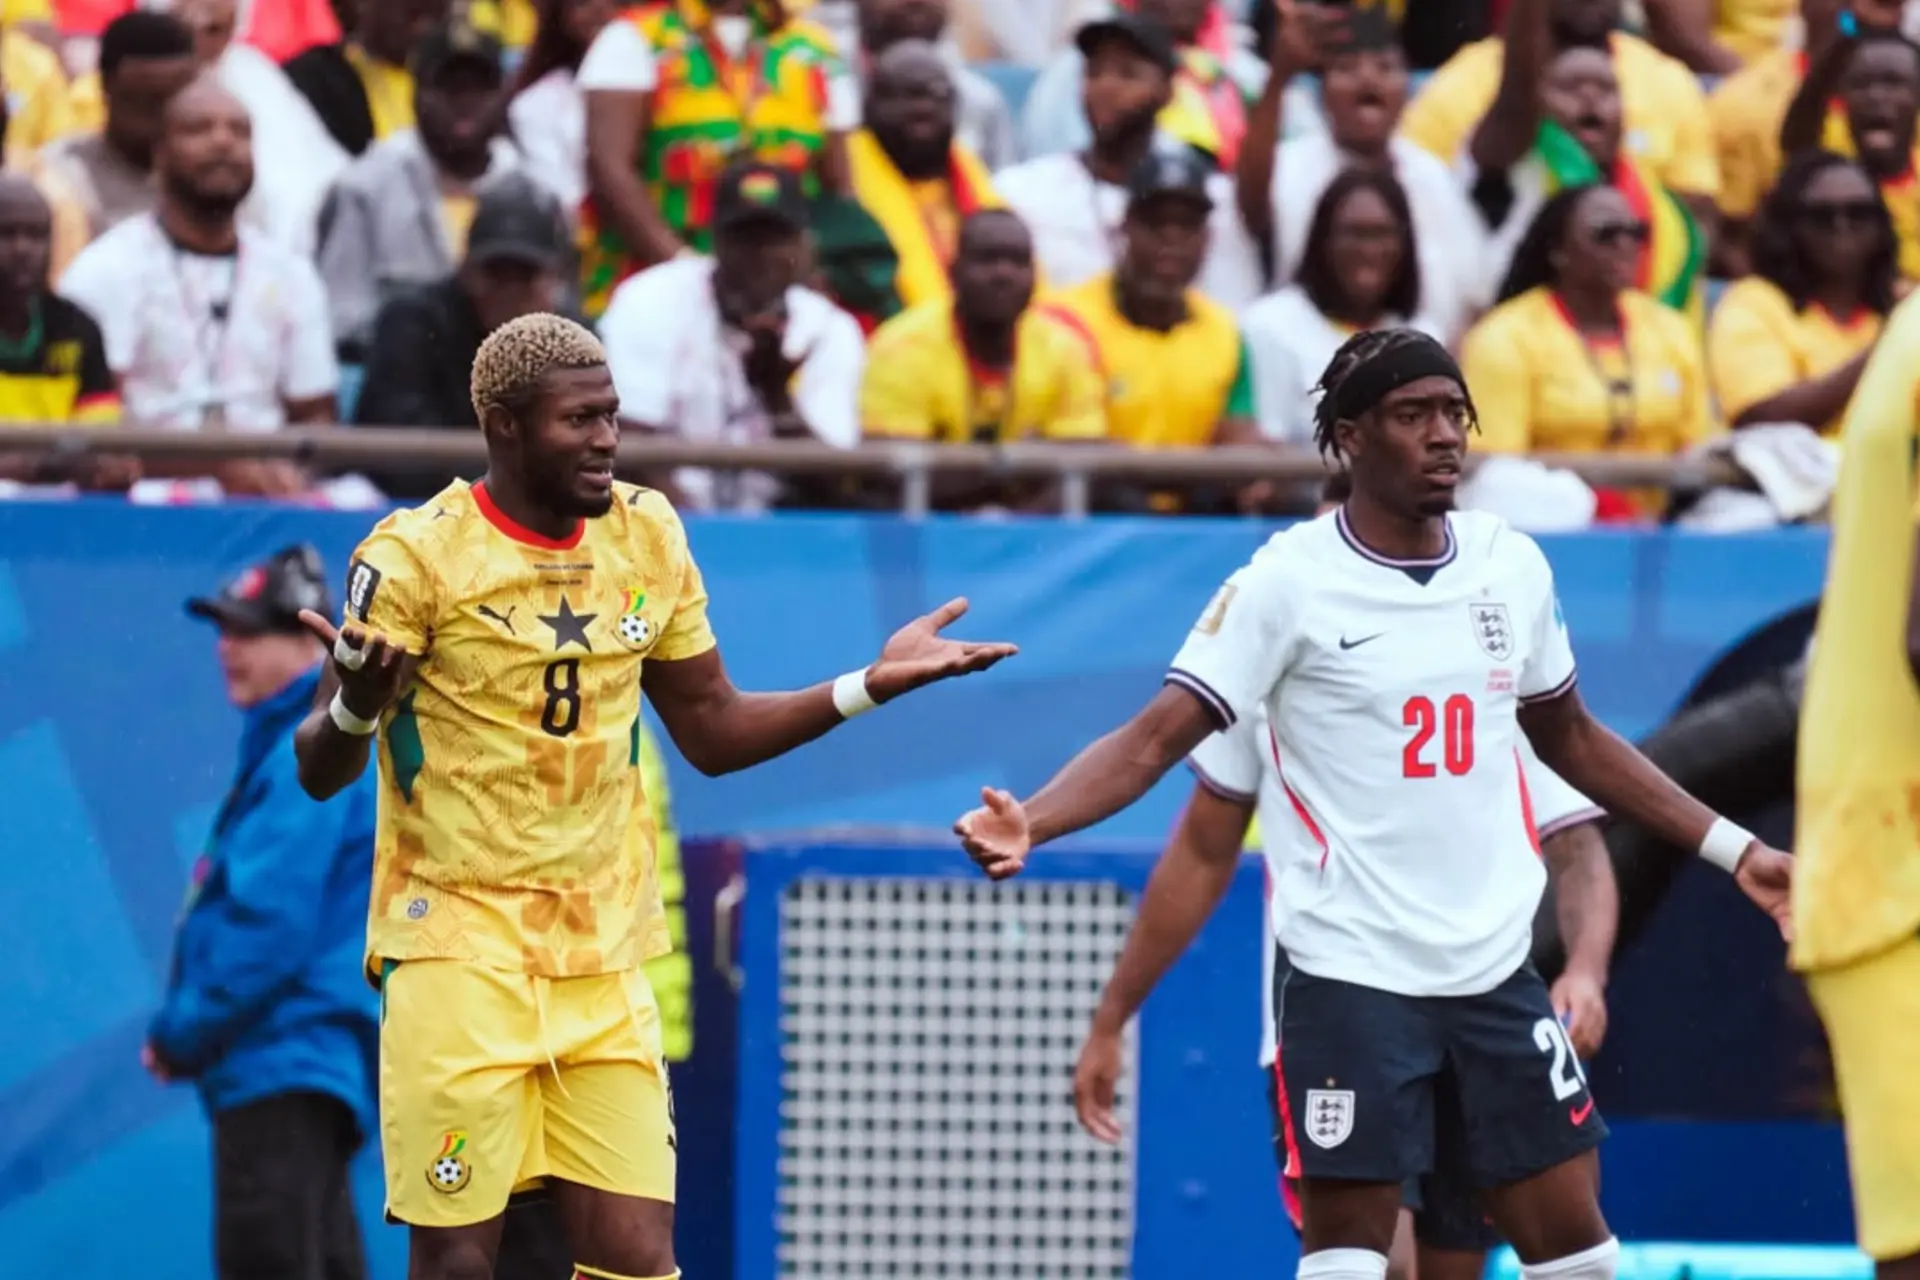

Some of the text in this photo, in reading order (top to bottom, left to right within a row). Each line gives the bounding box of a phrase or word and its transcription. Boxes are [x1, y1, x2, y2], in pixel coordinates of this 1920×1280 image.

[541, 658, 581, 737] 8
[1403, 693, 1474, 777] 20
[1532, 1017, 1587, 1101] 2
